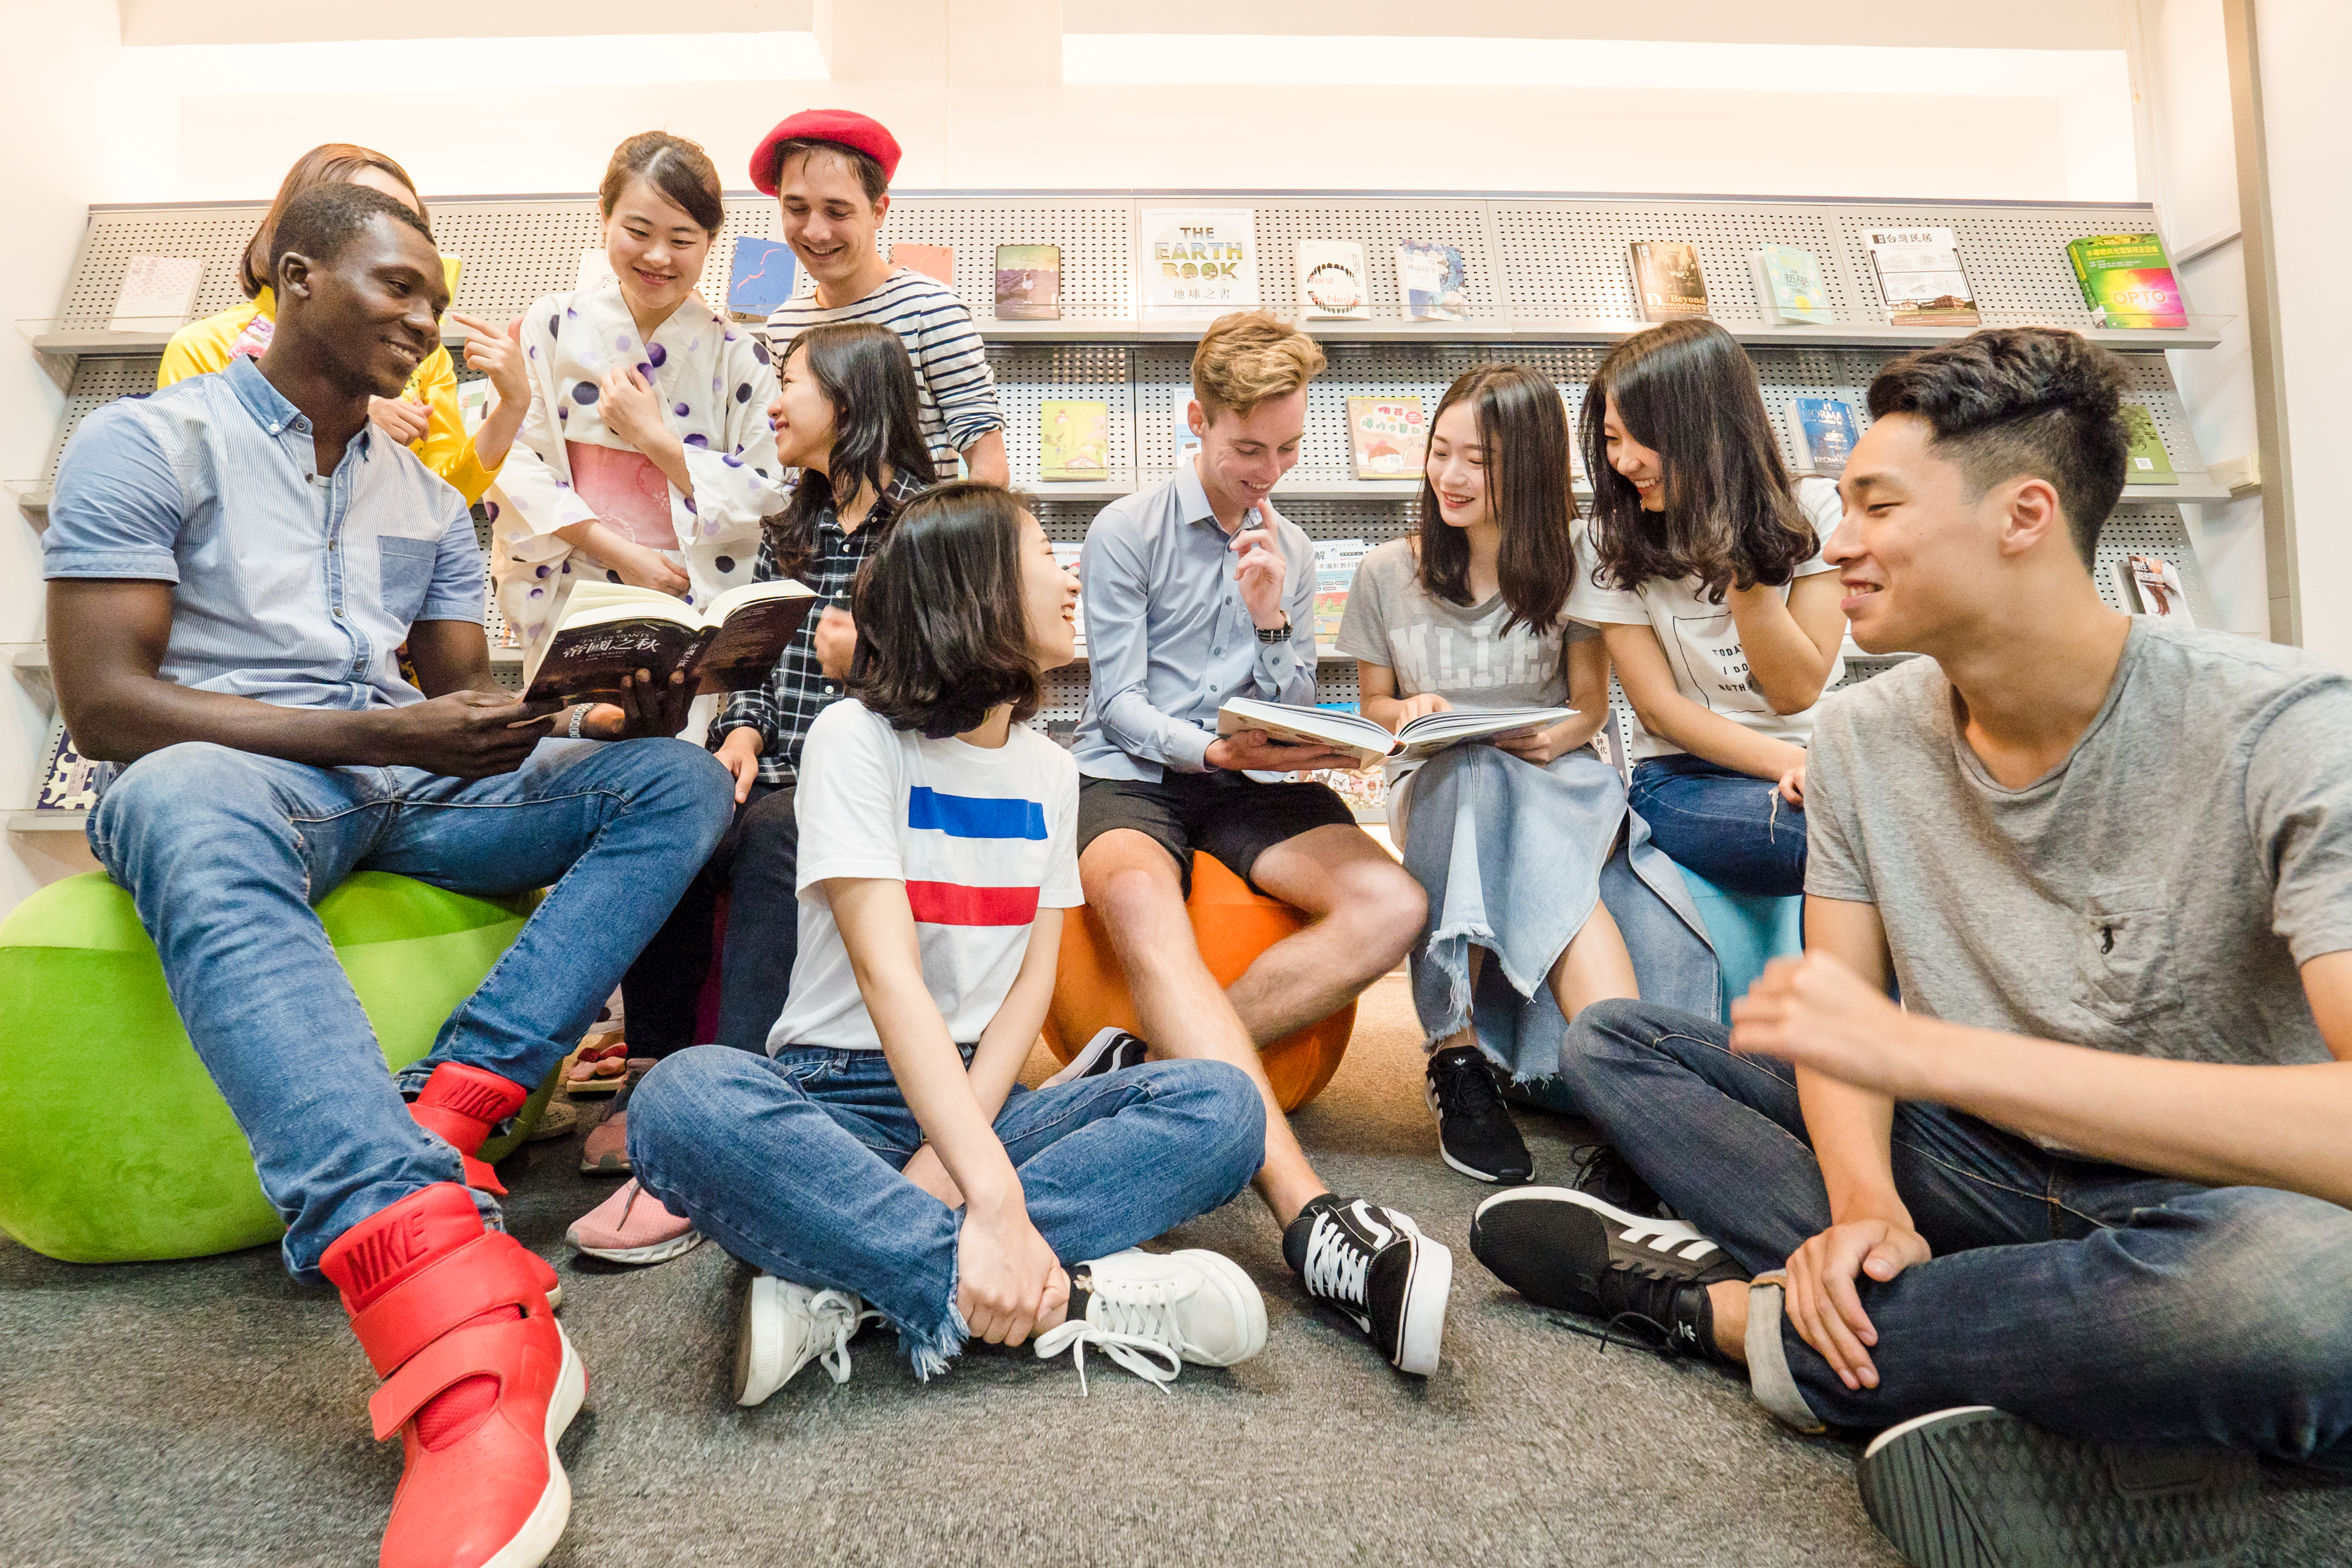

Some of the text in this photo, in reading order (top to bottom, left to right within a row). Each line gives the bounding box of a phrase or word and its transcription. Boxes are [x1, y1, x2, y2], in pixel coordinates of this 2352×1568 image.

[1179, 227, 1215, 239] THE
[1886, 233, 1932, 243] 台灣民居
[1155, 242, 1243, 260] EARTH
[1162, 263, 1239, 281] BOOK
[1784, 273, 1810, 289] 哲學
[1174, 289, 1230, 299] 地球之書
[1670, 294, 1706, 304] Beyond
[2113, 290, 2166, 304] OPTO
[1644, 293, 1708, 312] Democracy
[563, 637, 661, 658] 帝國之秋
[1723, 666, 1728, 675] I
[439, 1079, 508, 1119] NIKE
[344, 1208, 429, 1295] NIKE
